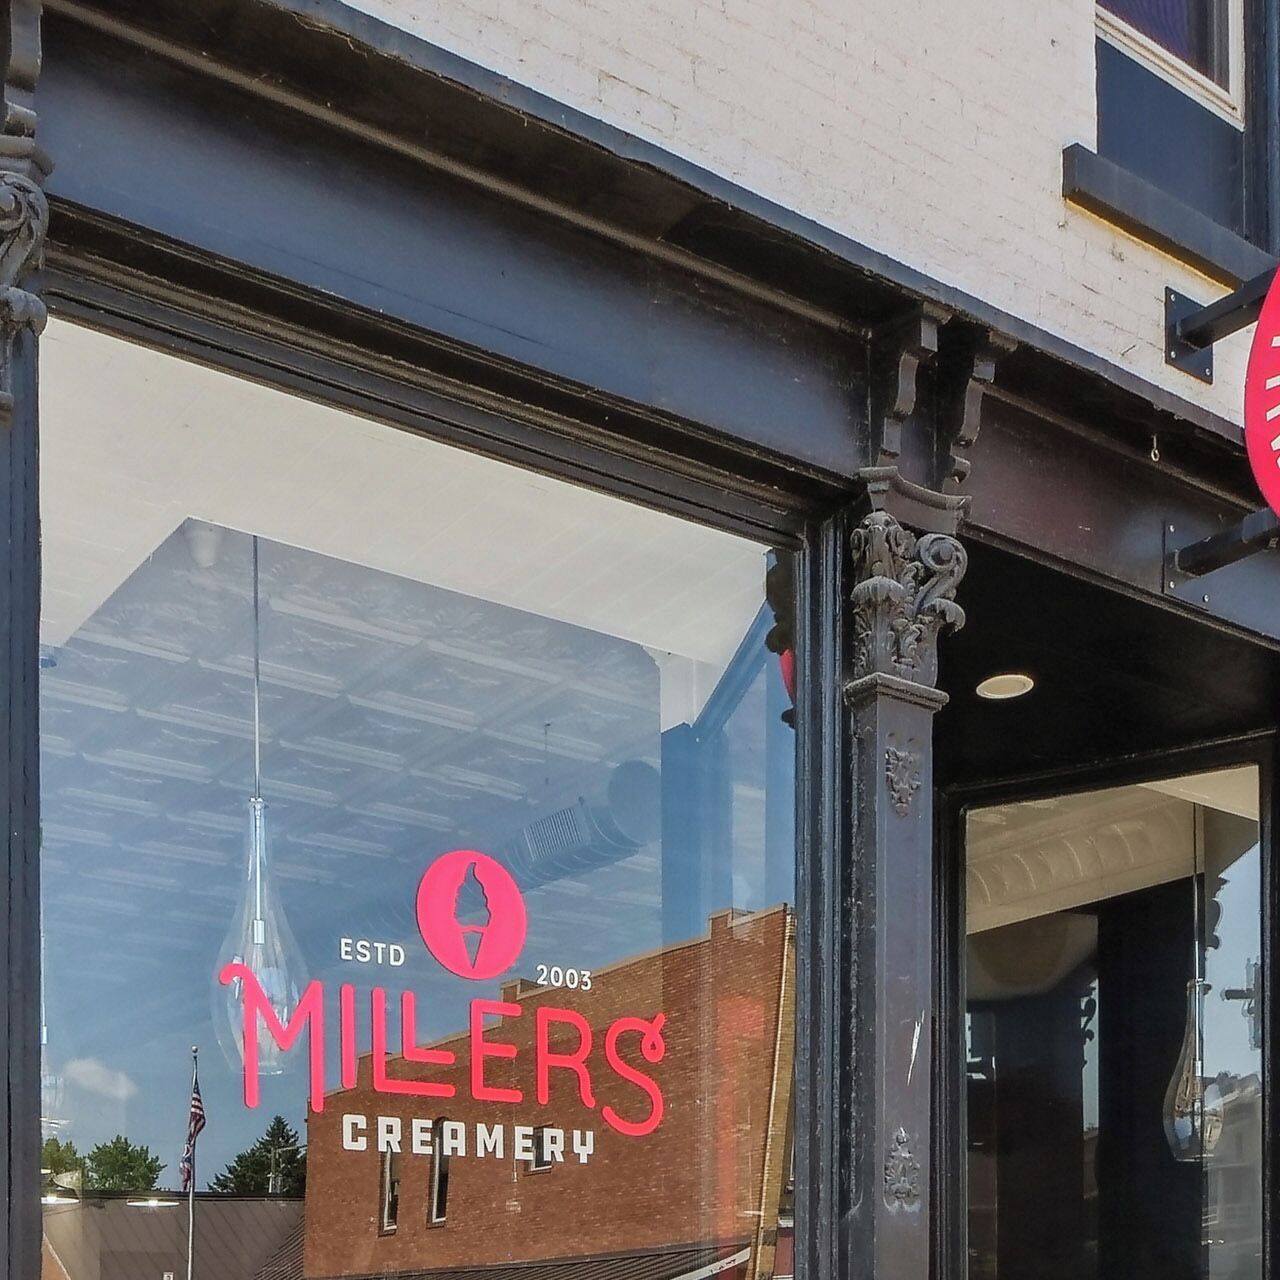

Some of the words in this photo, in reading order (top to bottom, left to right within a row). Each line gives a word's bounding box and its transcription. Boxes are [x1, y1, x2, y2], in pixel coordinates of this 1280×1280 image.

[340, 936, 405, 967] ESTD
[536, 963, 594, 991] 2003
[219, 961, 666, 1137] MILLERS
[341, 1114, 595, 1164] CREAMERY
